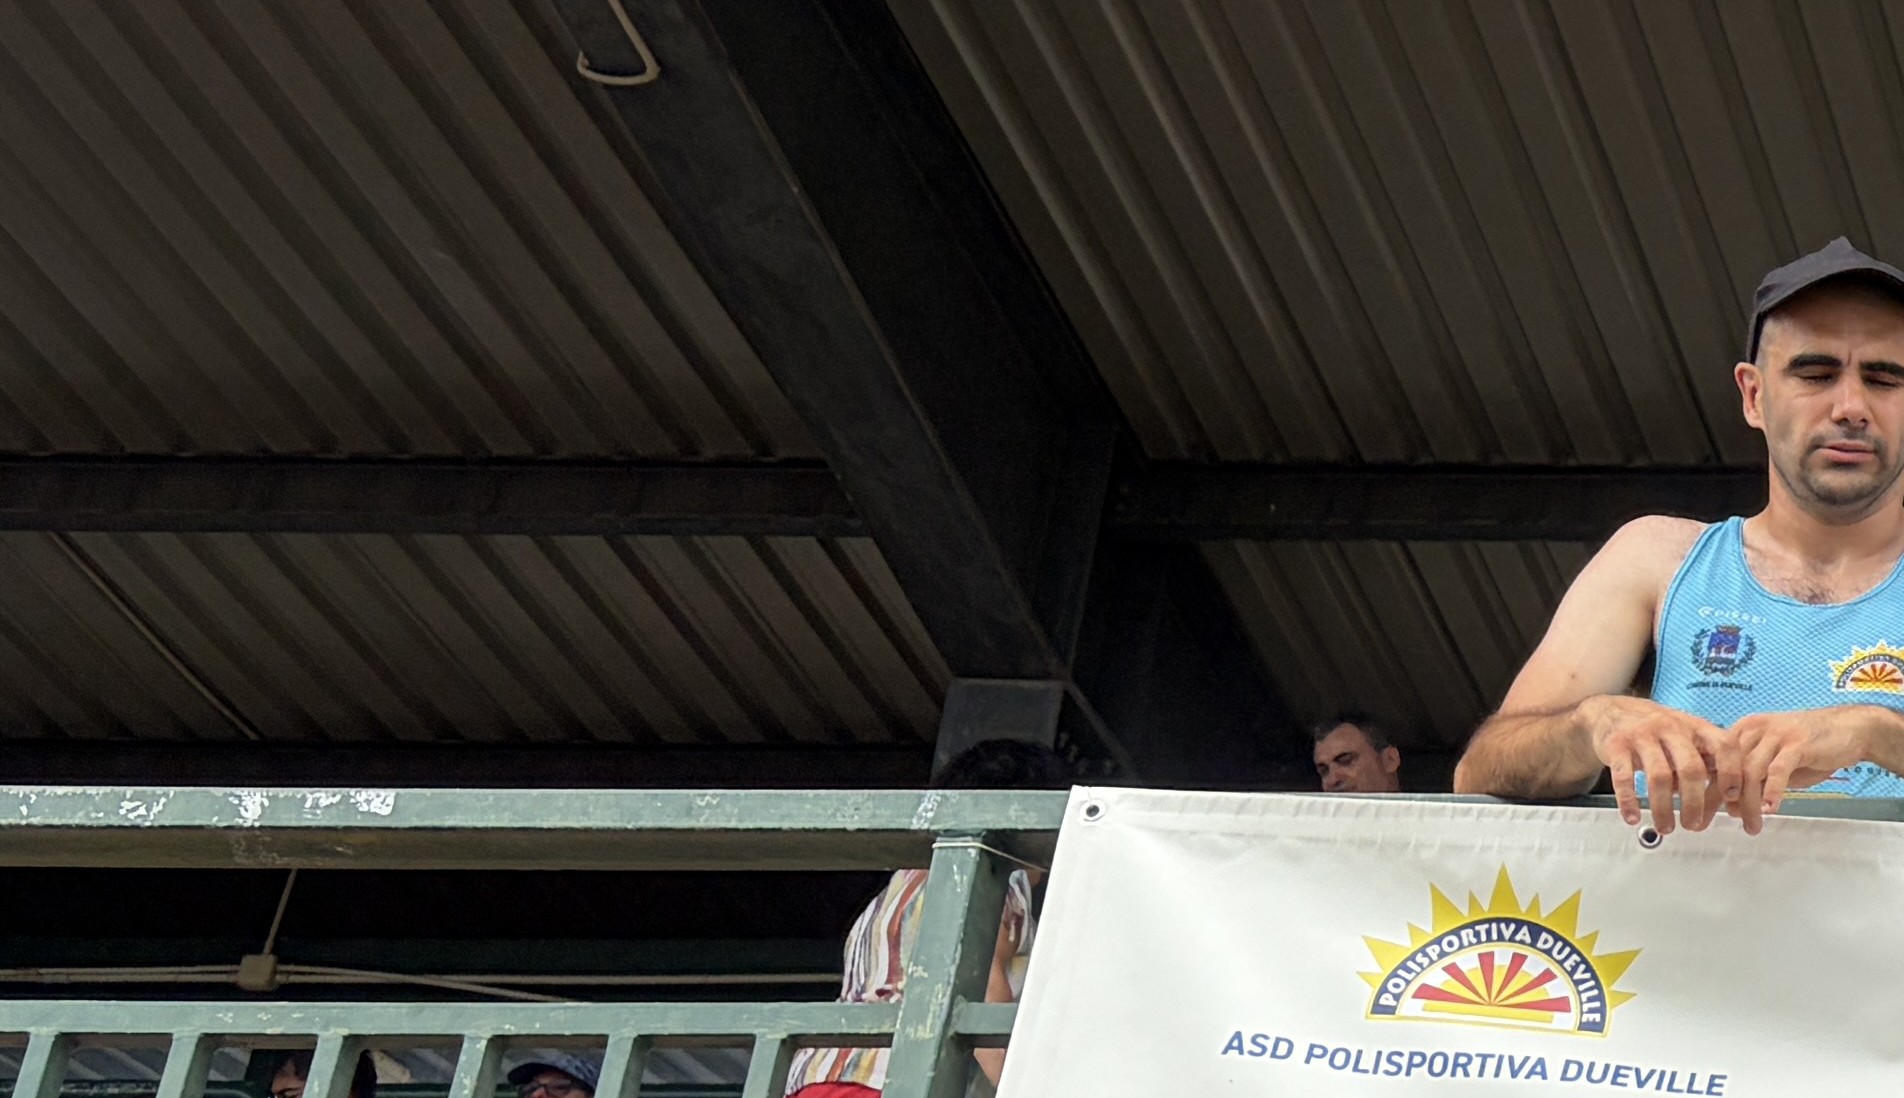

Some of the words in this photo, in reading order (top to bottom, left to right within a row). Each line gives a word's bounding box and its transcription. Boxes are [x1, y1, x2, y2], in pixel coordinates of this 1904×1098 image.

[1378, 921, 1533, 1007] POLISPORTIVA
[1536, 931, 1602, 1024] DUEVILLE
[1221, 1030, 1295, 1061] ASD
[1303, 1044, 1549, 1082] POLISPORTIVA
[1560, 1058, 1728, 1098] DUEVILLE
